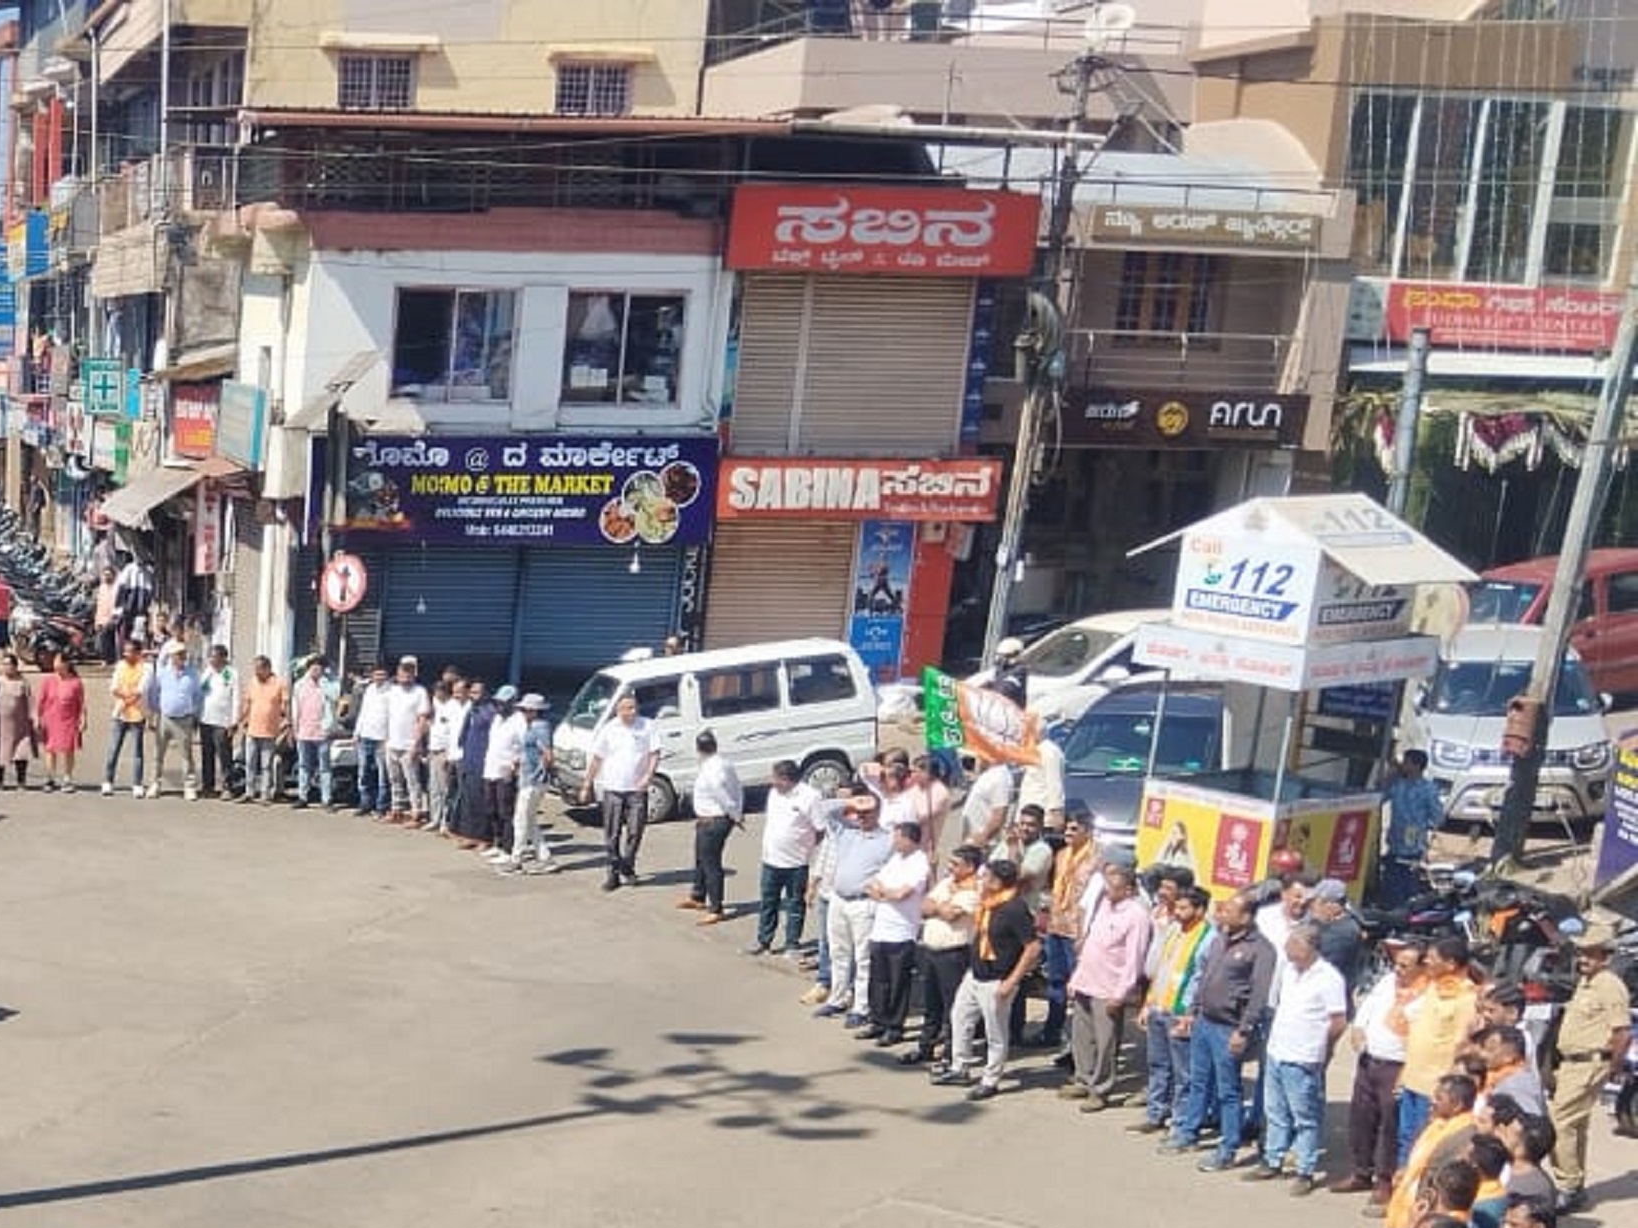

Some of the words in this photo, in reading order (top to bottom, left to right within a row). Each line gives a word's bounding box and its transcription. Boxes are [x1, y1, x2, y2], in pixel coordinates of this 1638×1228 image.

[775, 197, 996, 247] ಸಬಿನ
[464, 447, 490, 472] @
[503, 440, 528, 467] ದ
[493, 474, 531, 496] THE
[533, 474, 615, 497] MARKET
[728, 467, 881, 510] SABINA
[1188, 536, 1223, 555] Call
[1229, 558, 1295, 597] 112
[1188, 589, 1287, 620] EMERGENCY
